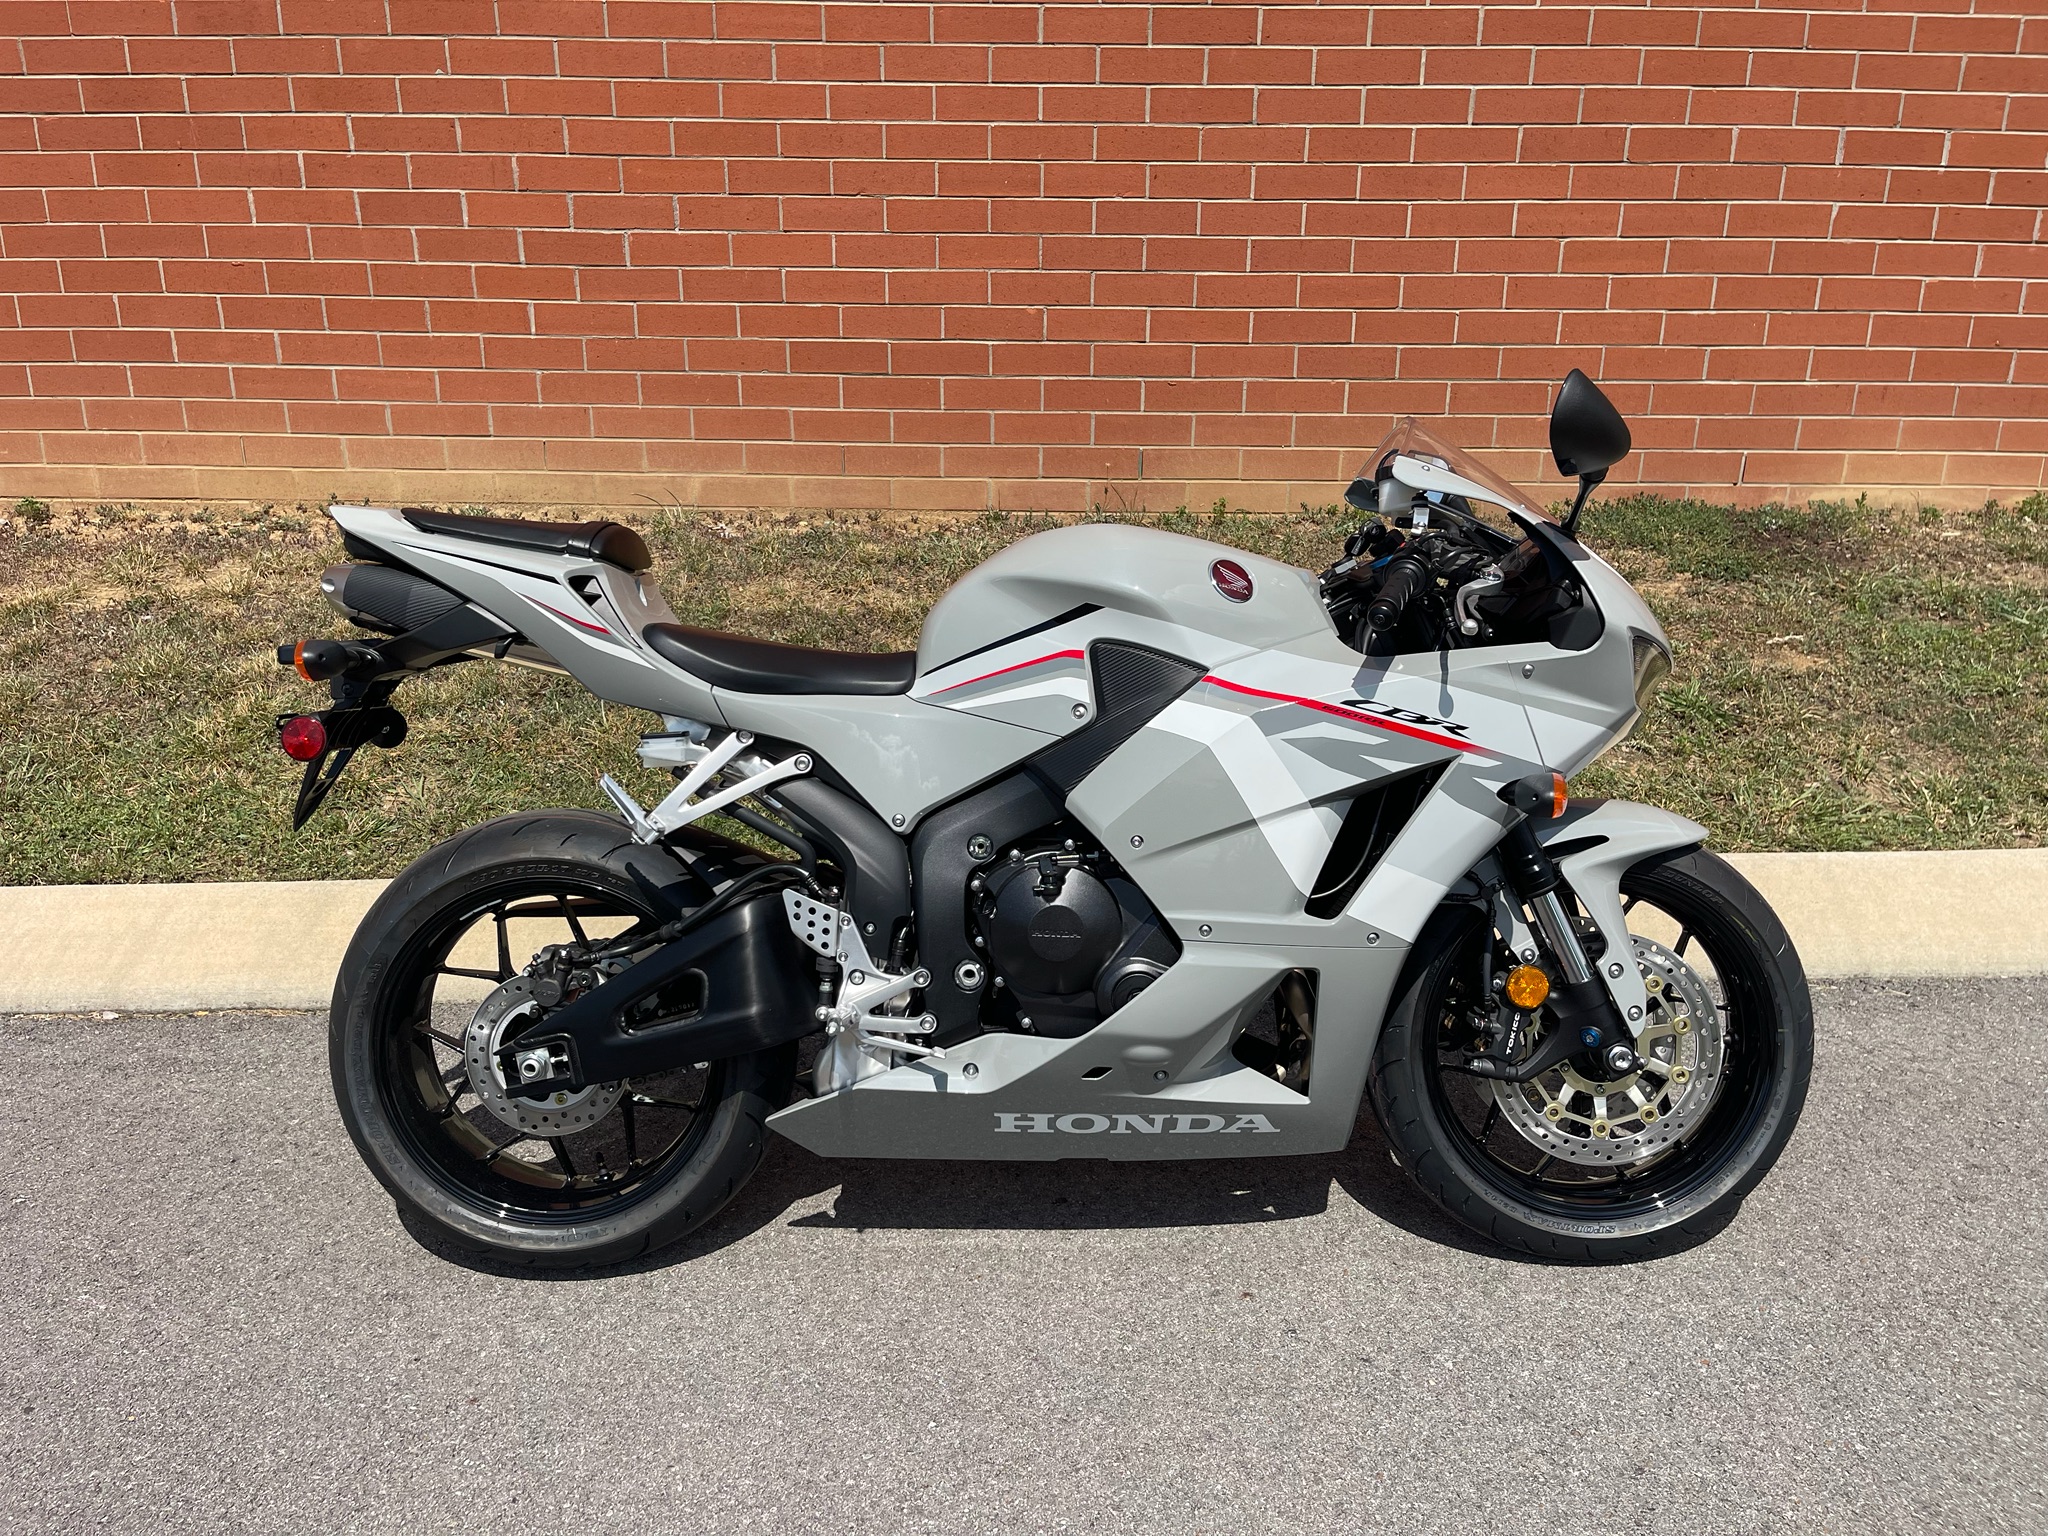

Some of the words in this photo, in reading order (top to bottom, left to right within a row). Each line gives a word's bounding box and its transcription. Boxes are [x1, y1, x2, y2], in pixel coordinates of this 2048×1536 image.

[1339, 700, 1472, 740] CBR
[1662, 869, 1724, 904] DUNLOP
[1031, 930, 1081, 939] HONDA
[1505, 1012, 1521, 1055] TOKICO
[994, 1112, 1281, 1134] HONDA
[1523, 1210, 1617, 1234] SPORTMAX
